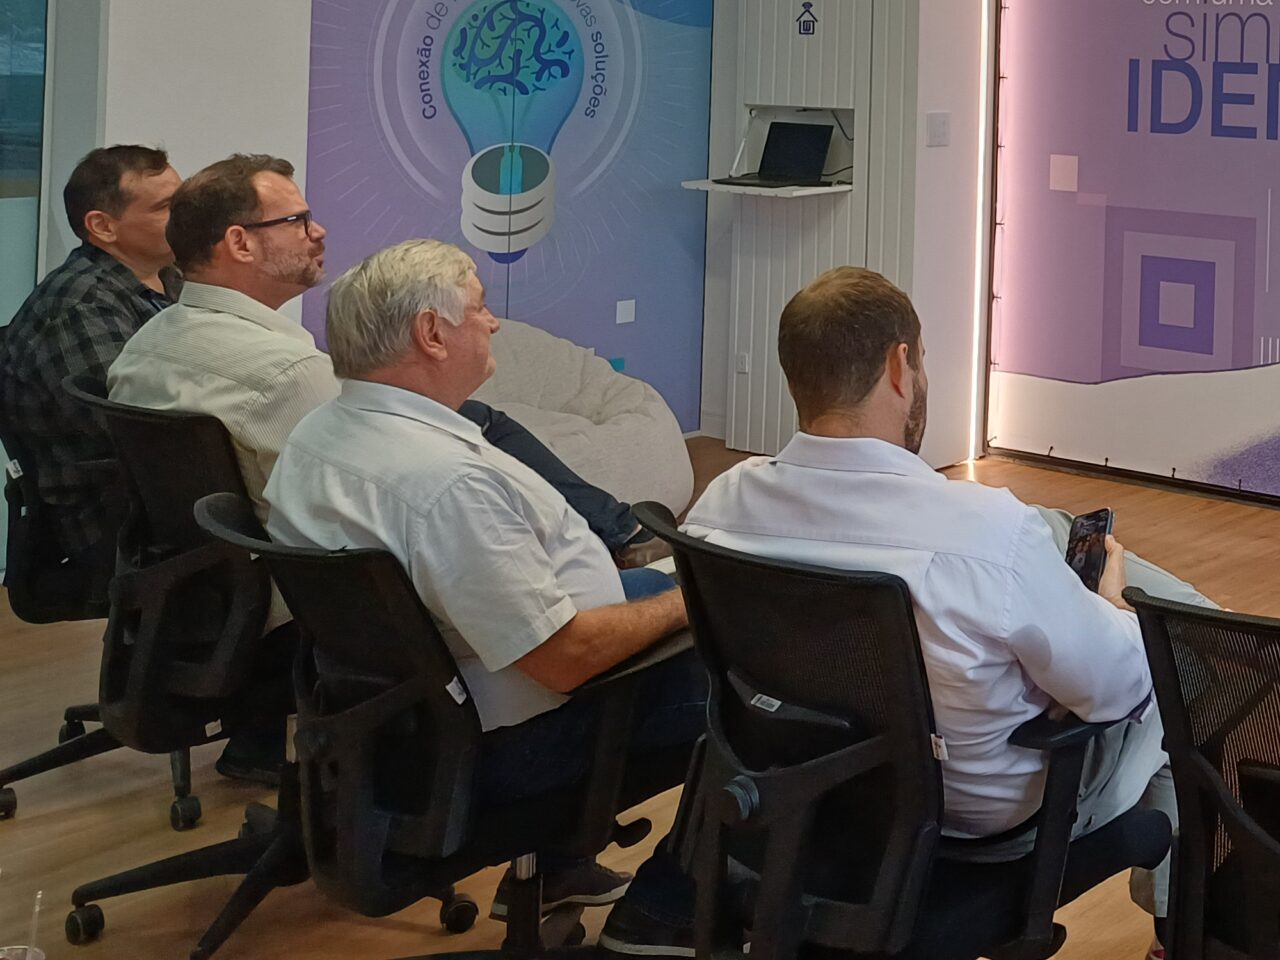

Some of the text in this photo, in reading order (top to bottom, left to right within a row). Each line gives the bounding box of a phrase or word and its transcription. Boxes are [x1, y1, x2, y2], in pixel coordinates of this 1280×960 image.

[426, 1, 449, 31] de
[416, 34, 438, 120] Conexão
[584, 30, 609, 119] soluções
